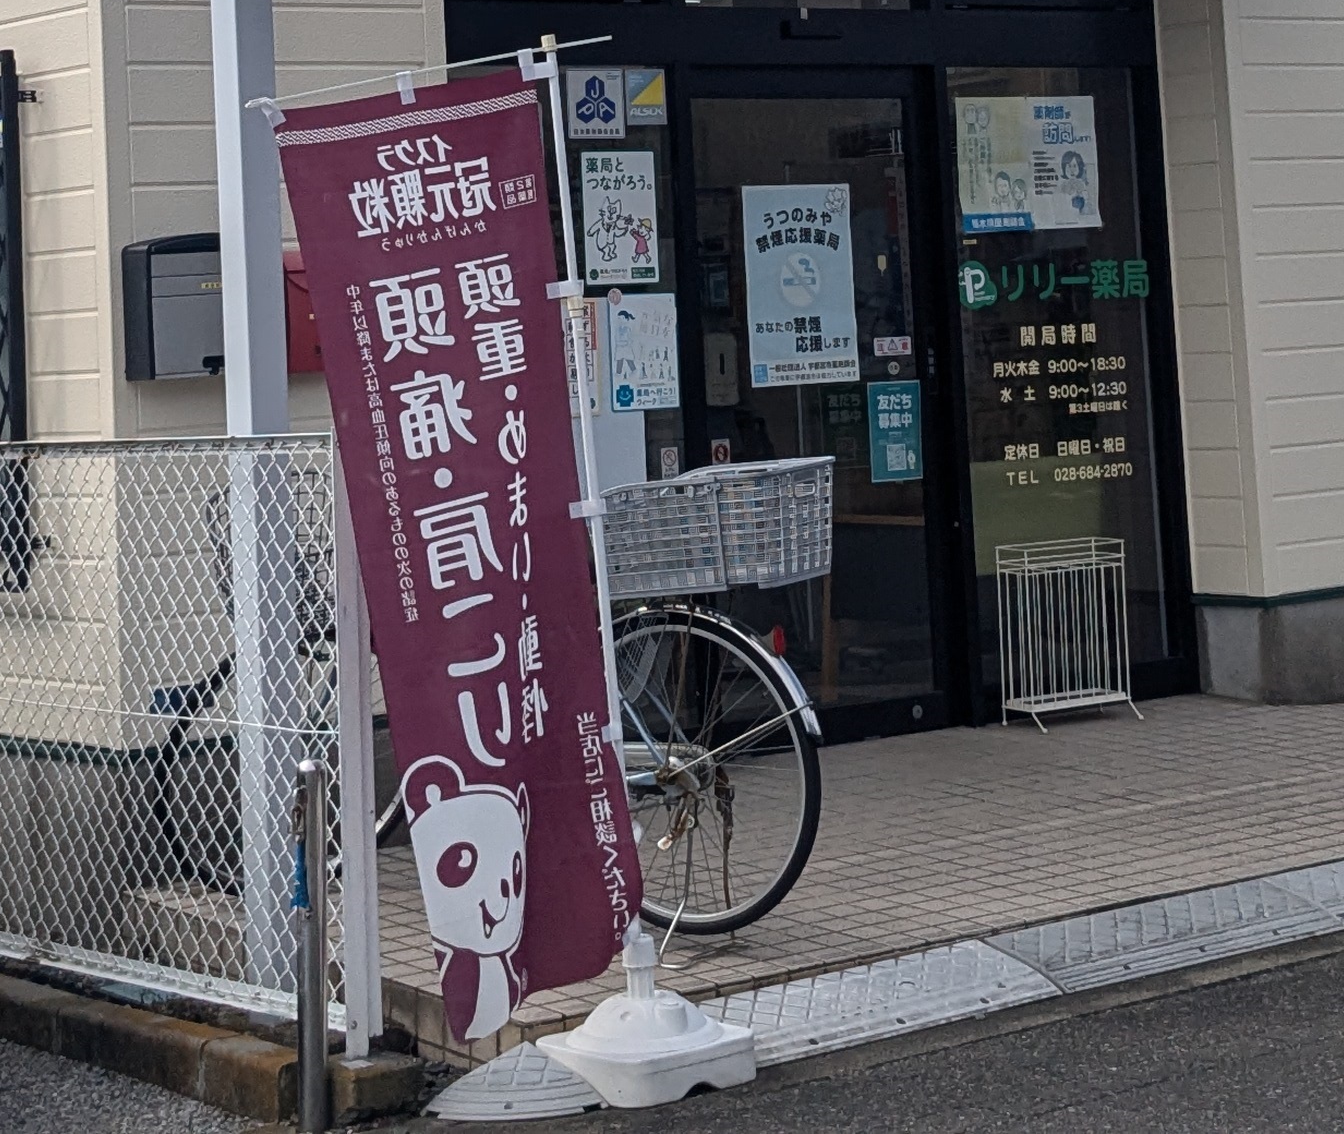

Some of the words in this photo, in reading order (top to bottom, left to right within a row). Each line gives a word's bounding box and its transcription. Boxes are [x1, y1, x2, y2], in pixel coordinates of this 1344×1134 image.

[585, 157, 625, 174] 薬局と
[586, 174, 653, 191] つながろう。
[763, 207, 833, 229] うつのみや
[755, 226, 841, 253] 禁煙応援薬局
[1001, 258, 1150, 301] リリー薬局
[755, 316, 823, 334] あなたの禁煙
[795, 334, 851, 353] 応援します
[1019, 323, 1097, 347] 開局時間
[992, 360, 1040, 379] 月火木金
[876, 393, 913, 411] 友だち
[999, 387, 1013, 403] 水
[1023, 385, 1036, 401] 土
[877, 411, 914, 429] 募集中
[1003, 443, 1040, 462] 定休日
[1056, 436, 1126, 458] 日曜日・祝日
[1005, 470, 1039, 486] TEL
[1053, 461, 1134, 483] 028-684-2870
